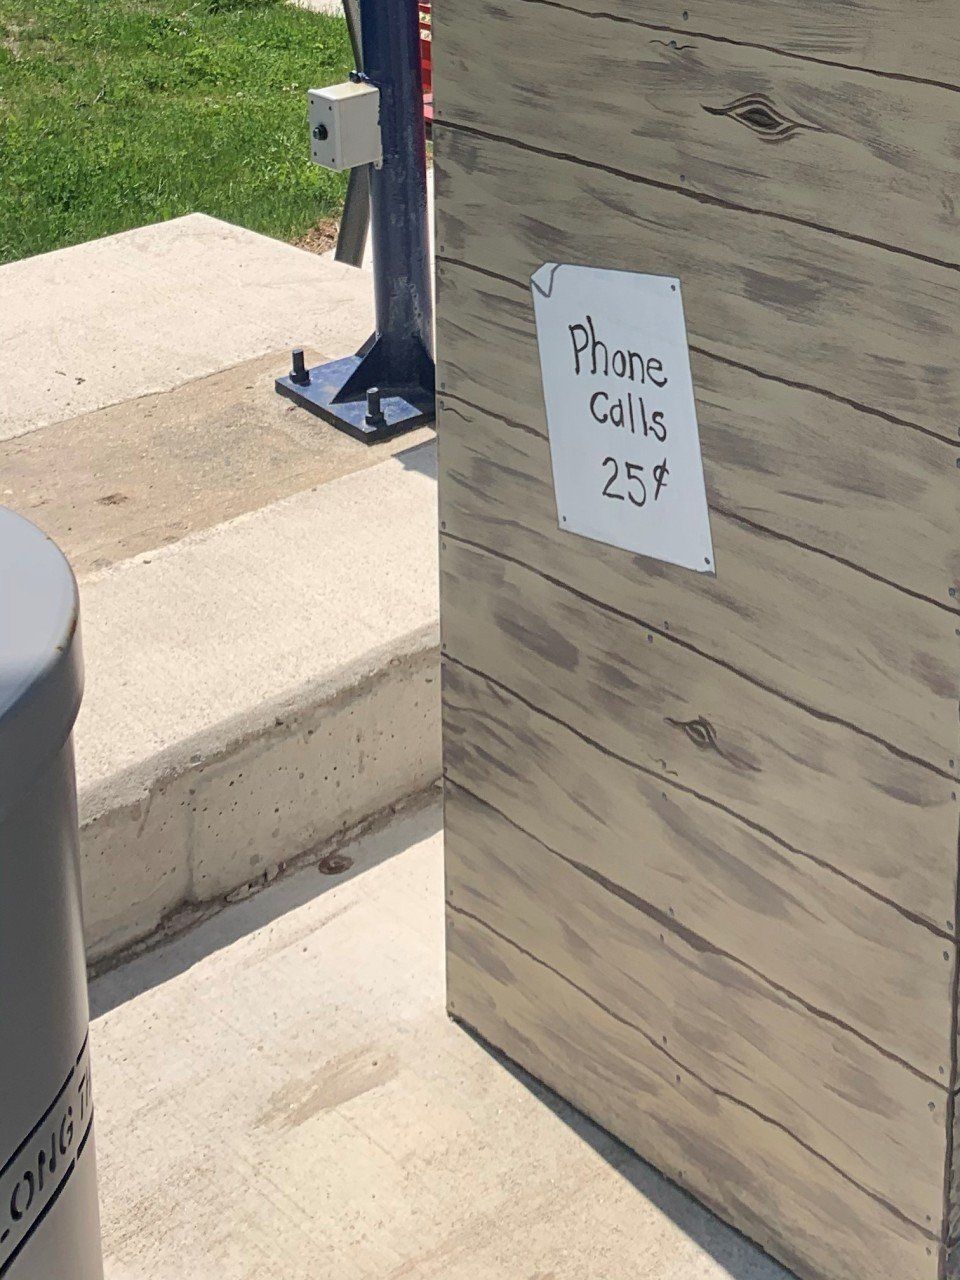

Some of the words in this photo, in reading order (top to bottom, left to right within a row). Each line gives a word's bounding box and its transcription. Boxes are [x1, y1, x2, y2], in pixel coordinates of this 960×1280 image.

[569, 315, 667, 387] Phone
[590, 391, 667, 442] Calls
[602, 457, 669, 506] 25¢
[0, 1106, 74, 1243] ONG
